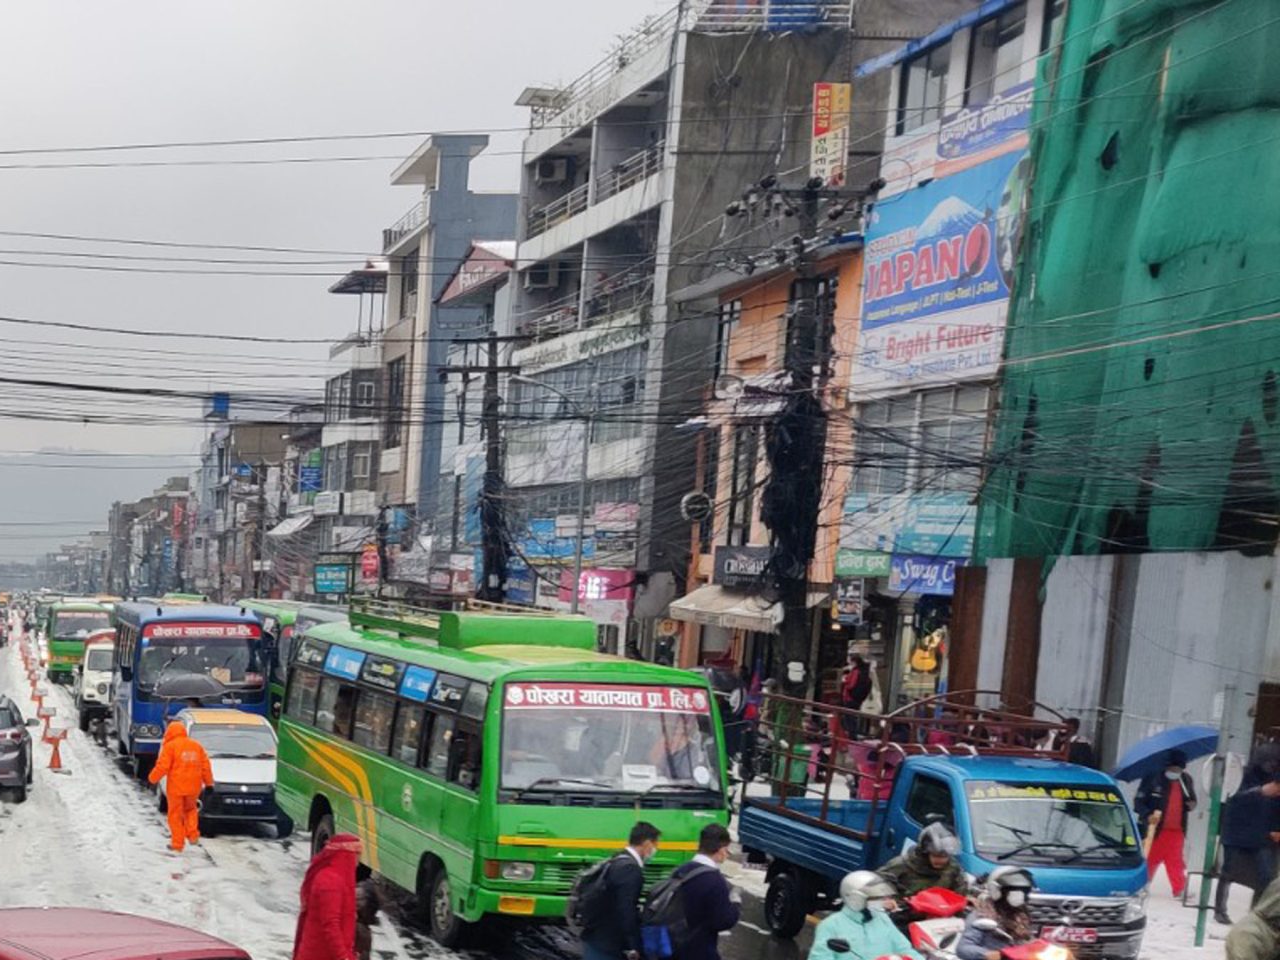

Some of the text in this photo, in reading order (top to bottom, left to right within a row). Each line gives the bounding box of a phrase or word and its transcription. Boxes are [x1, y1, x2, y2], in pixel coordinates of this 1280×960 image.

[865, 234, 963, 302] JAPAN
[886, 331, 931, 362] Bright
[936, 323, 994, 351] Future
[900, 559, 938, 586] Swag
[525, 686, 576, 706] पोखरा
[579, 688, 643, 707] यातायात
